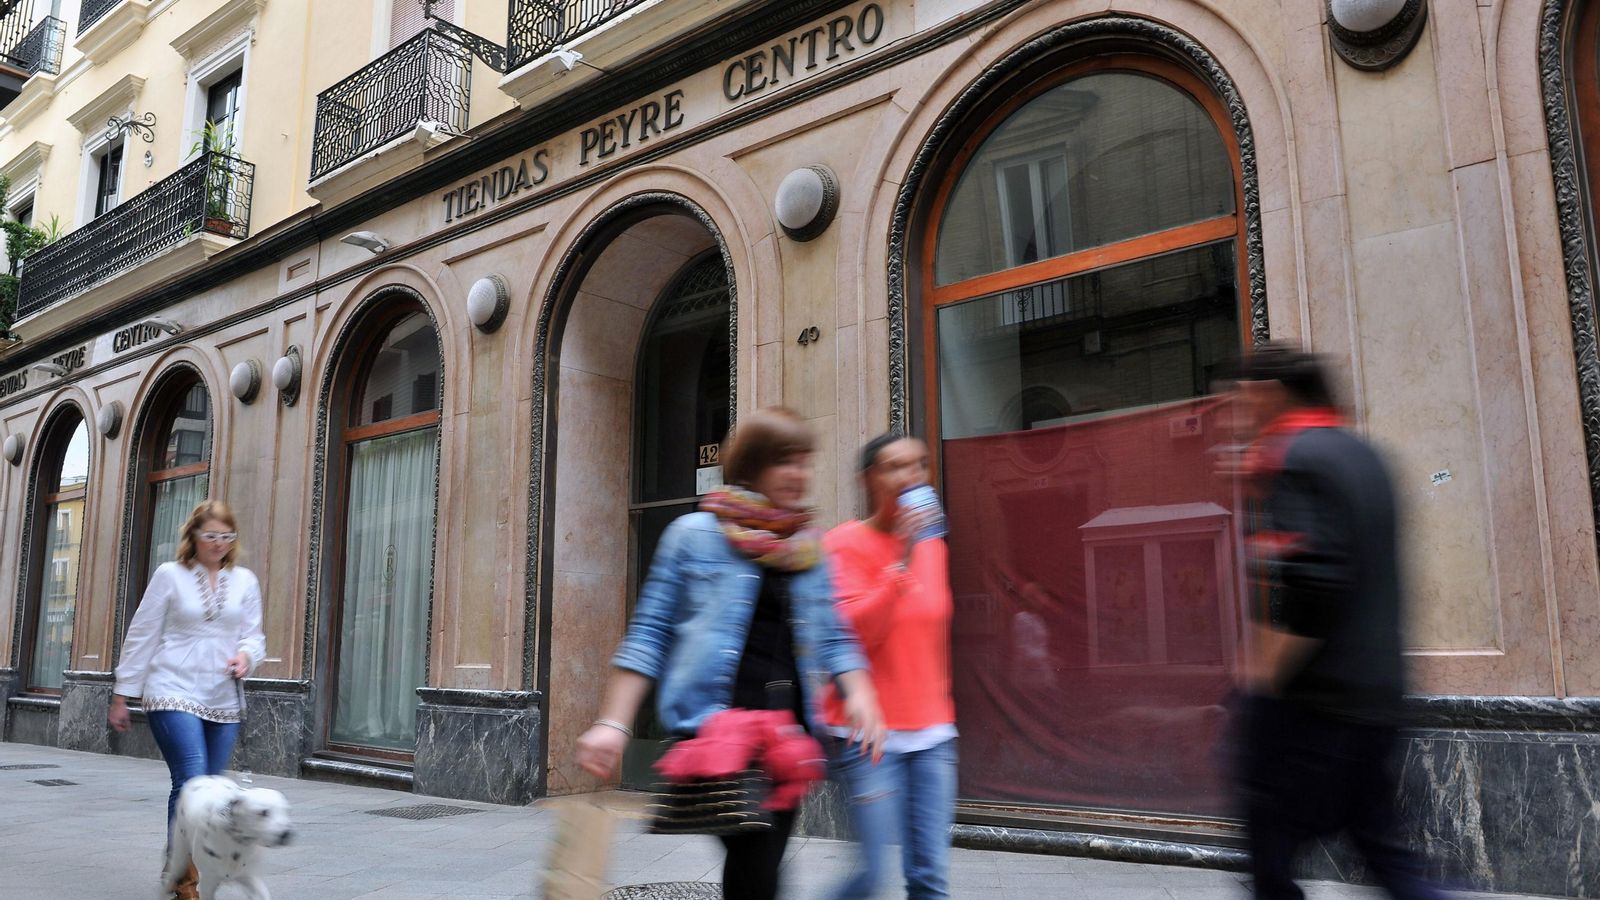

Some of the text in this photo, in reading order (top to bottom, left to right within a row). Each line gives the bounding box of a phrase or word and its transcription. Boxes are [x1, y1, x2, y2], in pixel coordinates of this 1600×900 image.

[443, 3, 884, 222] TIENDAS PEYRE CENTRO
[700, 445, 718, 464] 42
